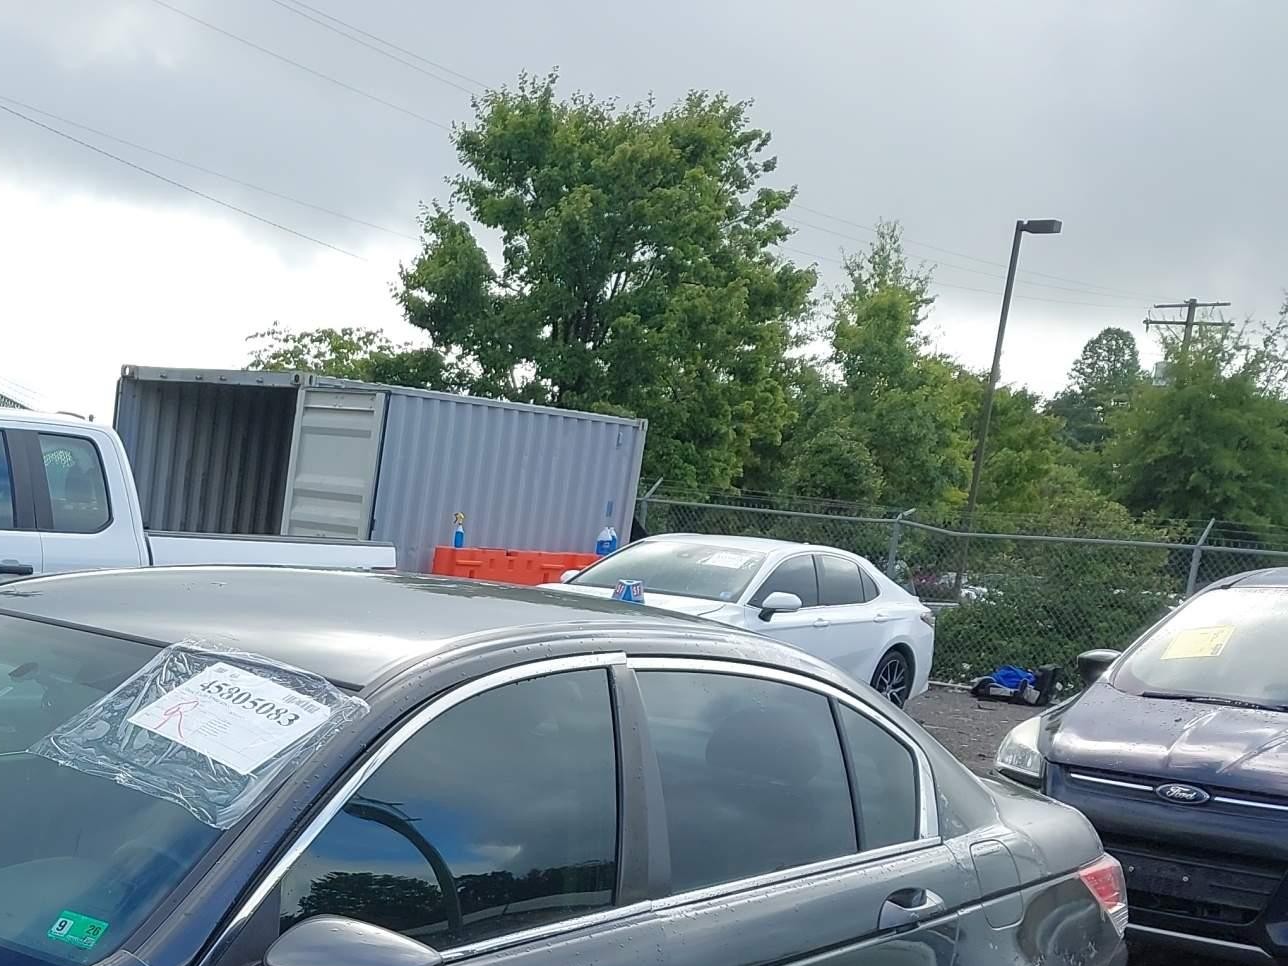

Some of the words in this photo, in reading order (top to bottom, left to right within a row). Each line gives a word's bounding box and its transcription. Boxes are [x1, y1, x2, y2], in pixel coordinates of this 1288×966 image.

[199, 680, 300, 726] 45805083
[1166, 786, 1197, 800] Ford
[56, 920, 68, 931] 9
[86, 925, 102, 936] 26
